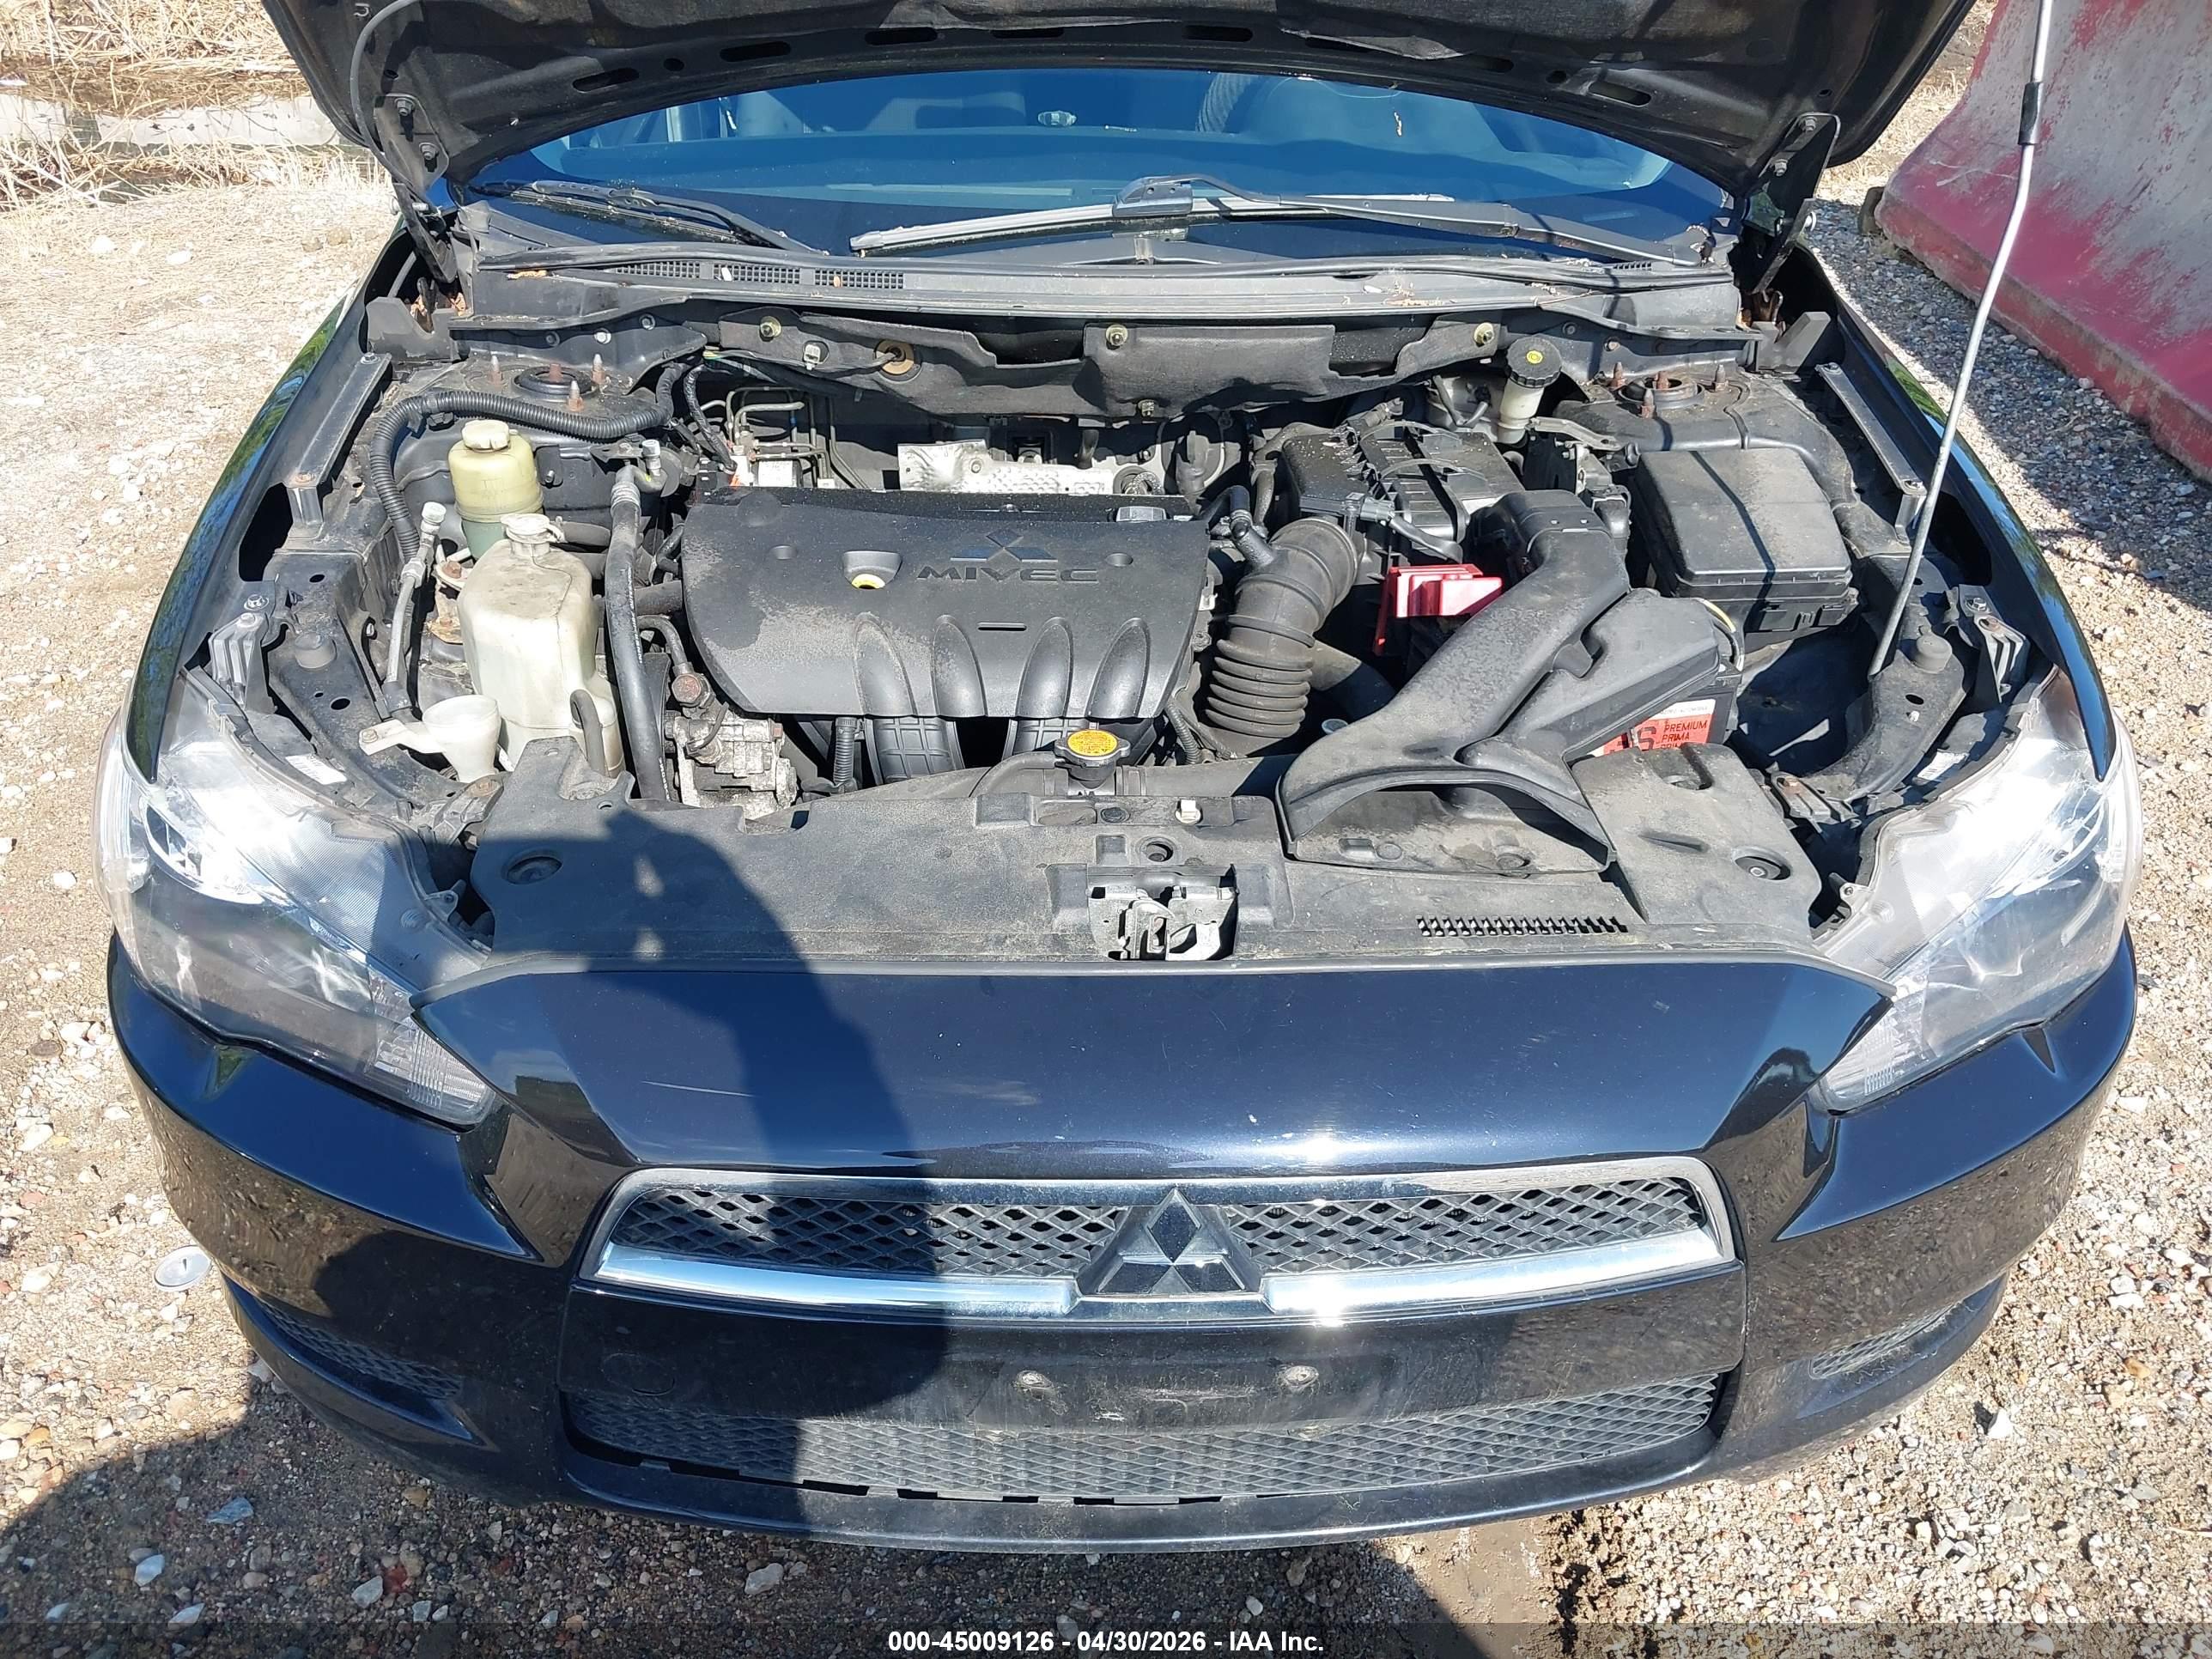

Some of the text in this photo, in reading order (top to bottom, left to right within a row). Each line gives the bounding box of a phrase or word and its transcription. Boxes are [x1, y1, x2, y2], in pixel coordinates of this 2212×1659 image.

[916, 567, 1099, 584] MIVEC
[1664, 720, 1708, 732] PREMIUM
[1661, 732, 1690, 743] PRIMA
